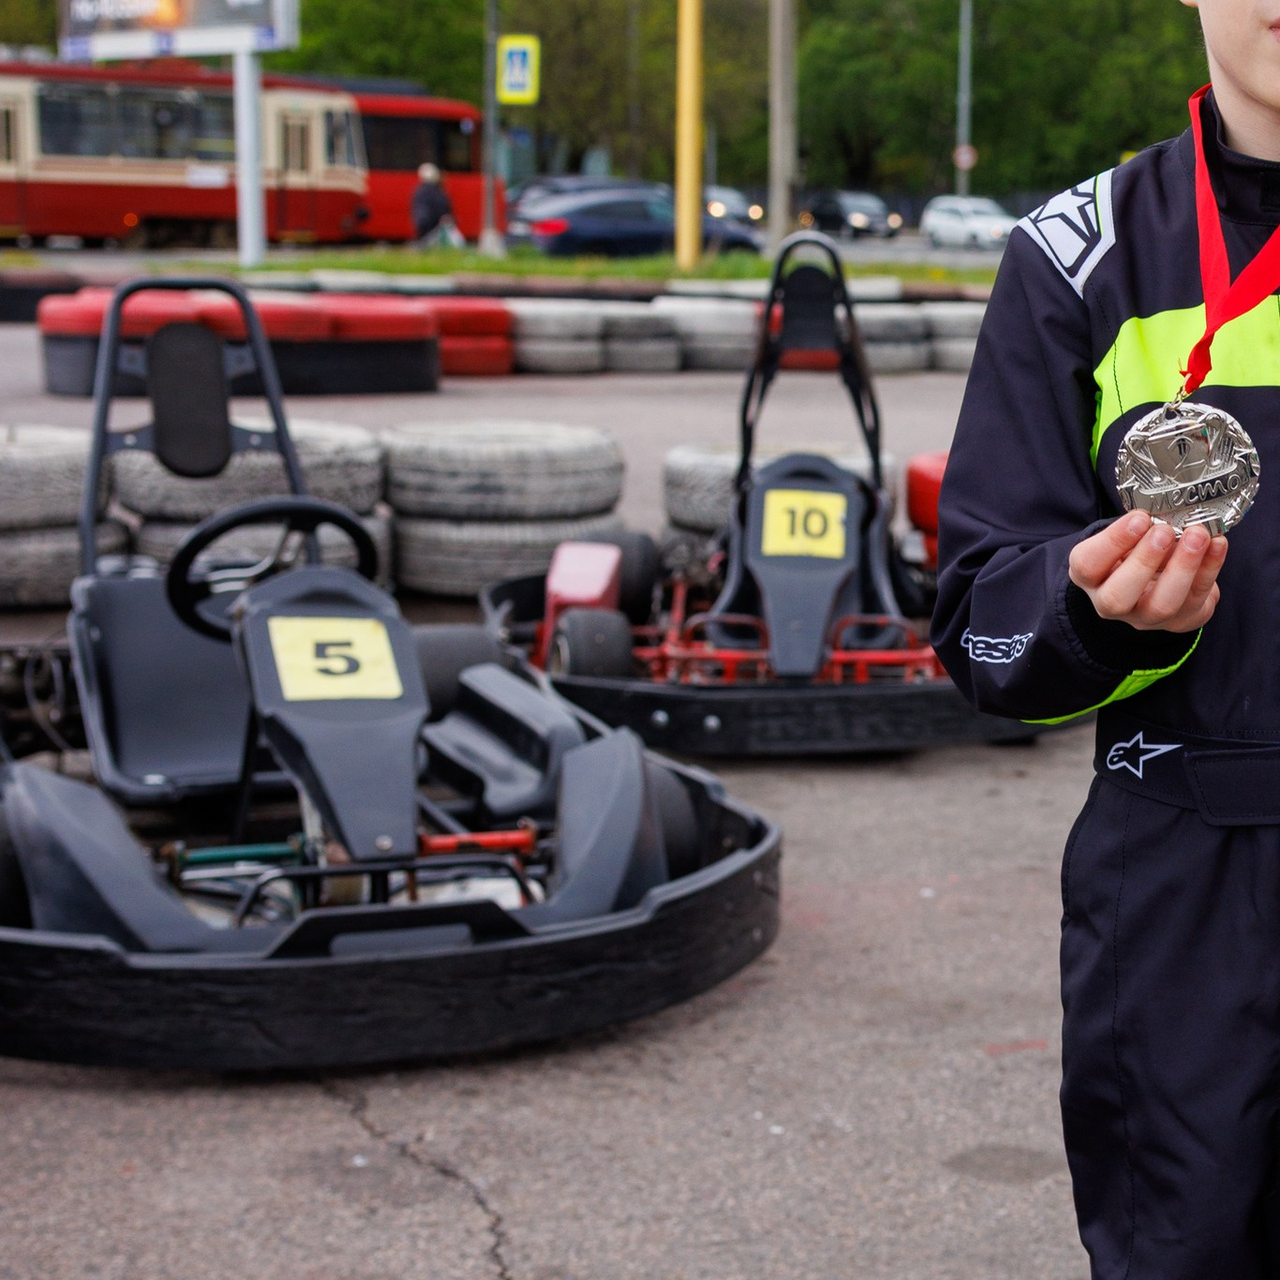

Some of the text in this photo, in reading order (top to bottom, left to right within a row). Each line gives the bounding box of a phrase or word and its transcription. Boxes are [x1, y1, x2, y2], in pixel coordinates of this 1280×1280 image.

[1167, 435, 1206, 475] 2
[784, 508, 828, 539] 10
[314, 641, 361, 676] 5
